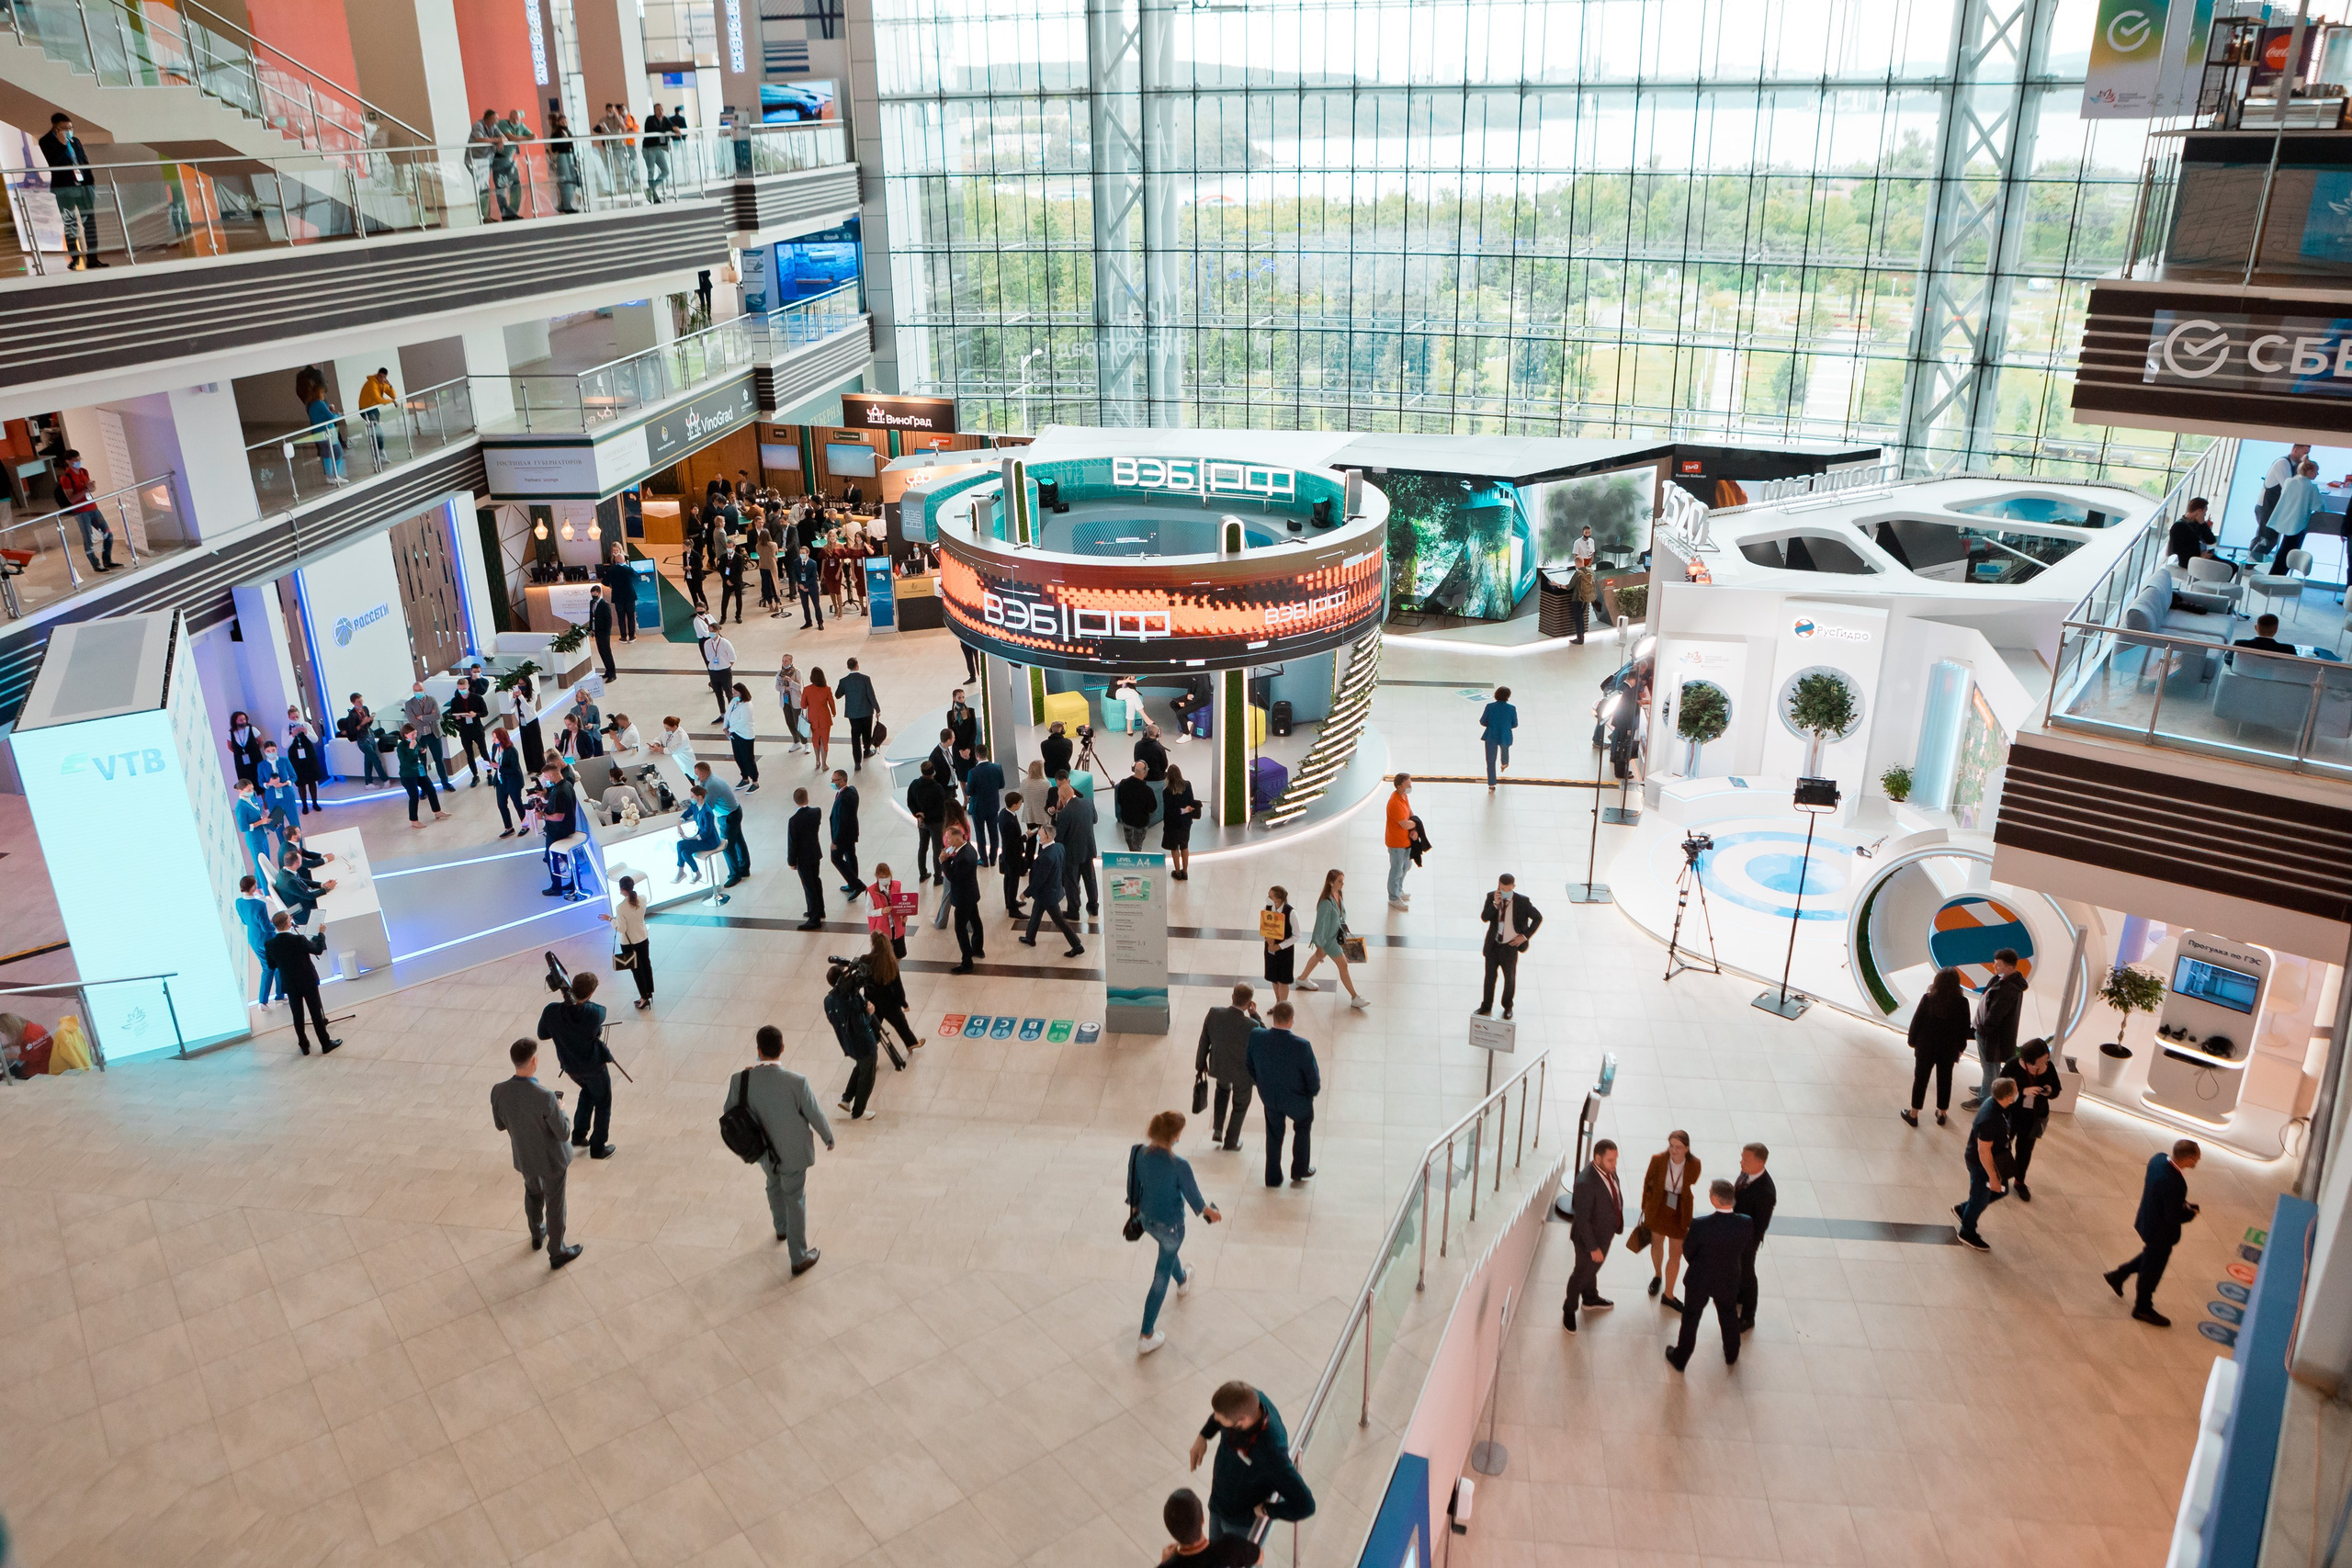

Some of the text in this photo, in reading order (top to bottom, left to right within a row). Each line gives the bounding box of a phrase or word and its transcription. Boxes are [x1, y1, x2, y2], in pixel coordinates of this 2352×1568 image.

[701, 405, 734, 434] VinoGrad
[886, 414, 932, 428] ВиноГрад
[903, 509, 922, 519] ВЭБ
[353, 603, 390, 632] РОССЕТИ
[1816, 626, 1870, 641] РусГидро
[92, 748, 166, 781] VTB
[1136, 858, 1151, 868] A4
[2188, 939, 2229, 956] Прогулка
[2244, 955, 2263, 966] ГЭС
[973, 1019, 984, 1027] D
[1000, 1020, 1010, 1028] C
[1028, 1021, 1039, 1030] B
